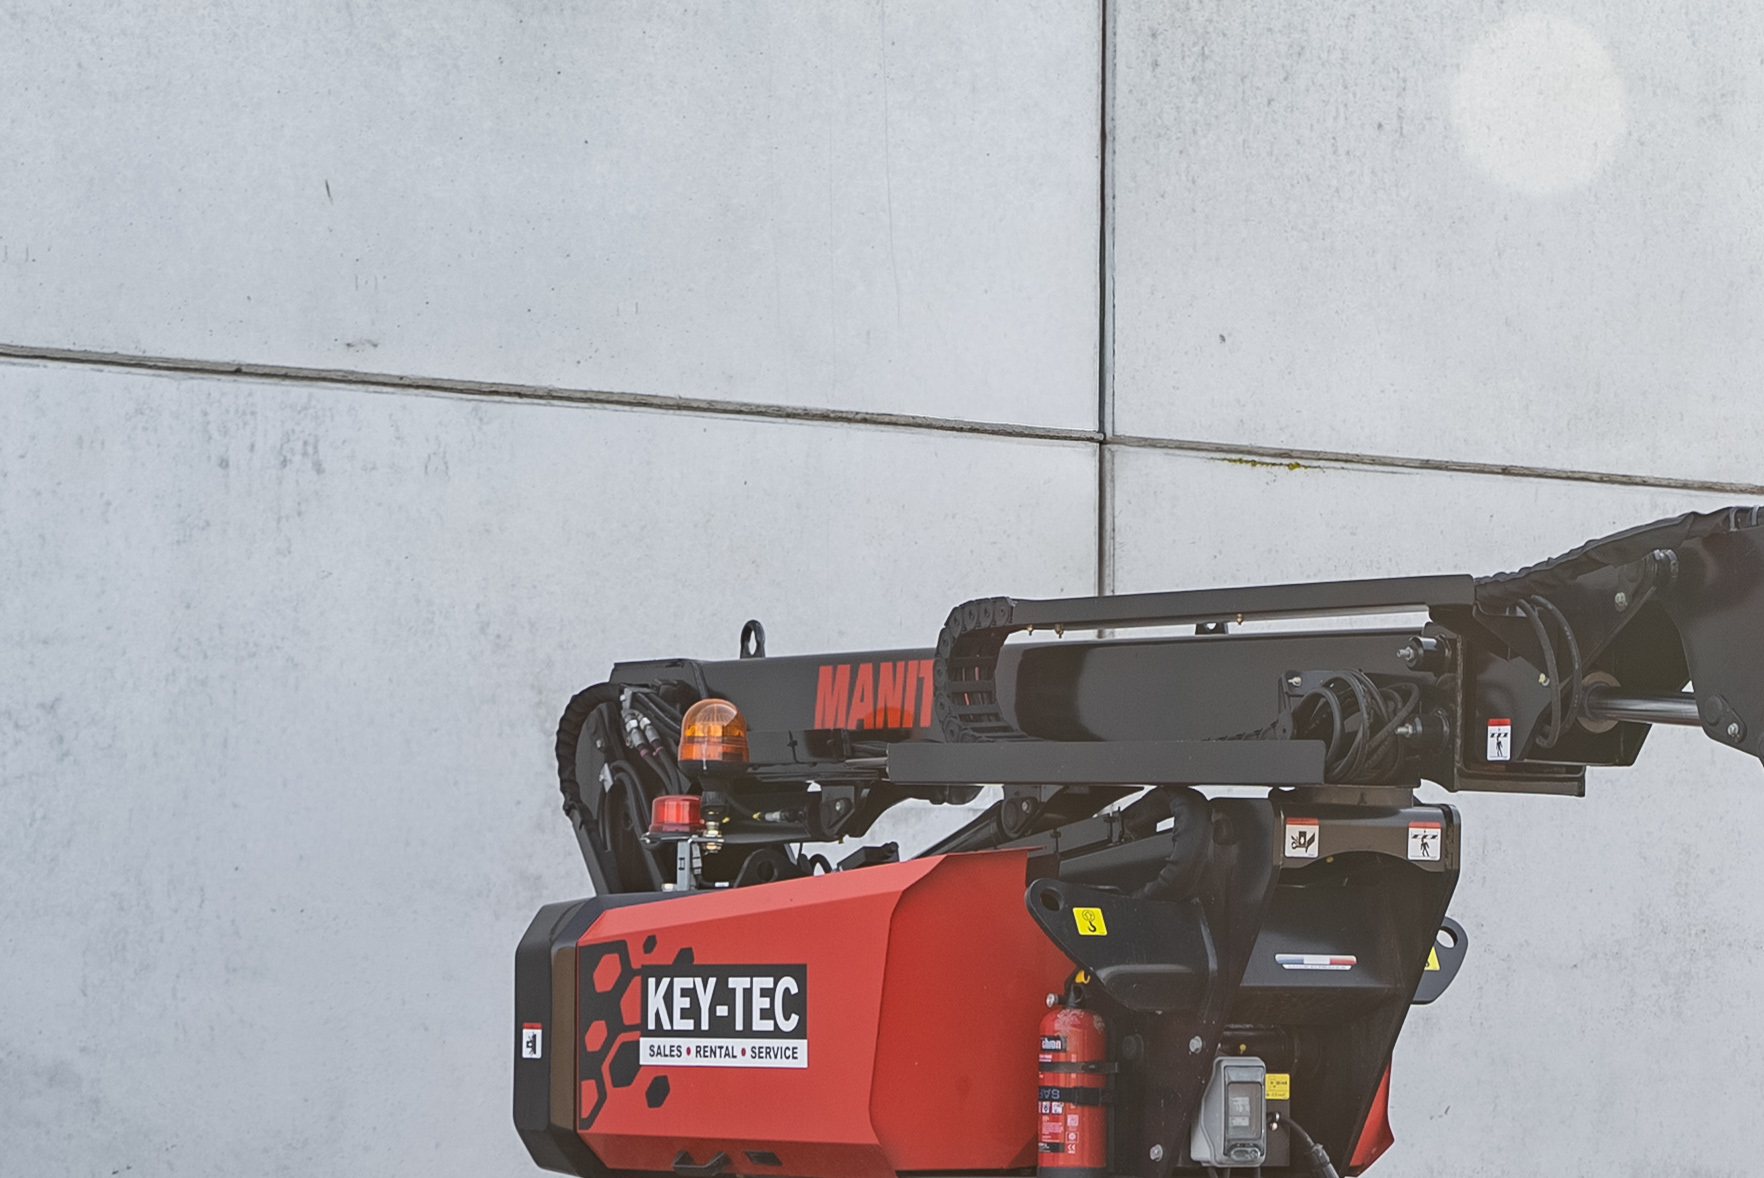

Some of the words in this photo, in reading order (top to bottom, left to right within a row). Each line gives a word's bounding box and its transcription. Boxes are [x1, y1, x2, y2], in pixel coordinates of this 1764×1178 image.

[647, 976, 800, 1032] KEY-TEC
[649, 1044, 683, 1058] SALES
[695, 1045, 737, 1059] RENTAL
[750, 1046, 798, 1060] SERVICE
